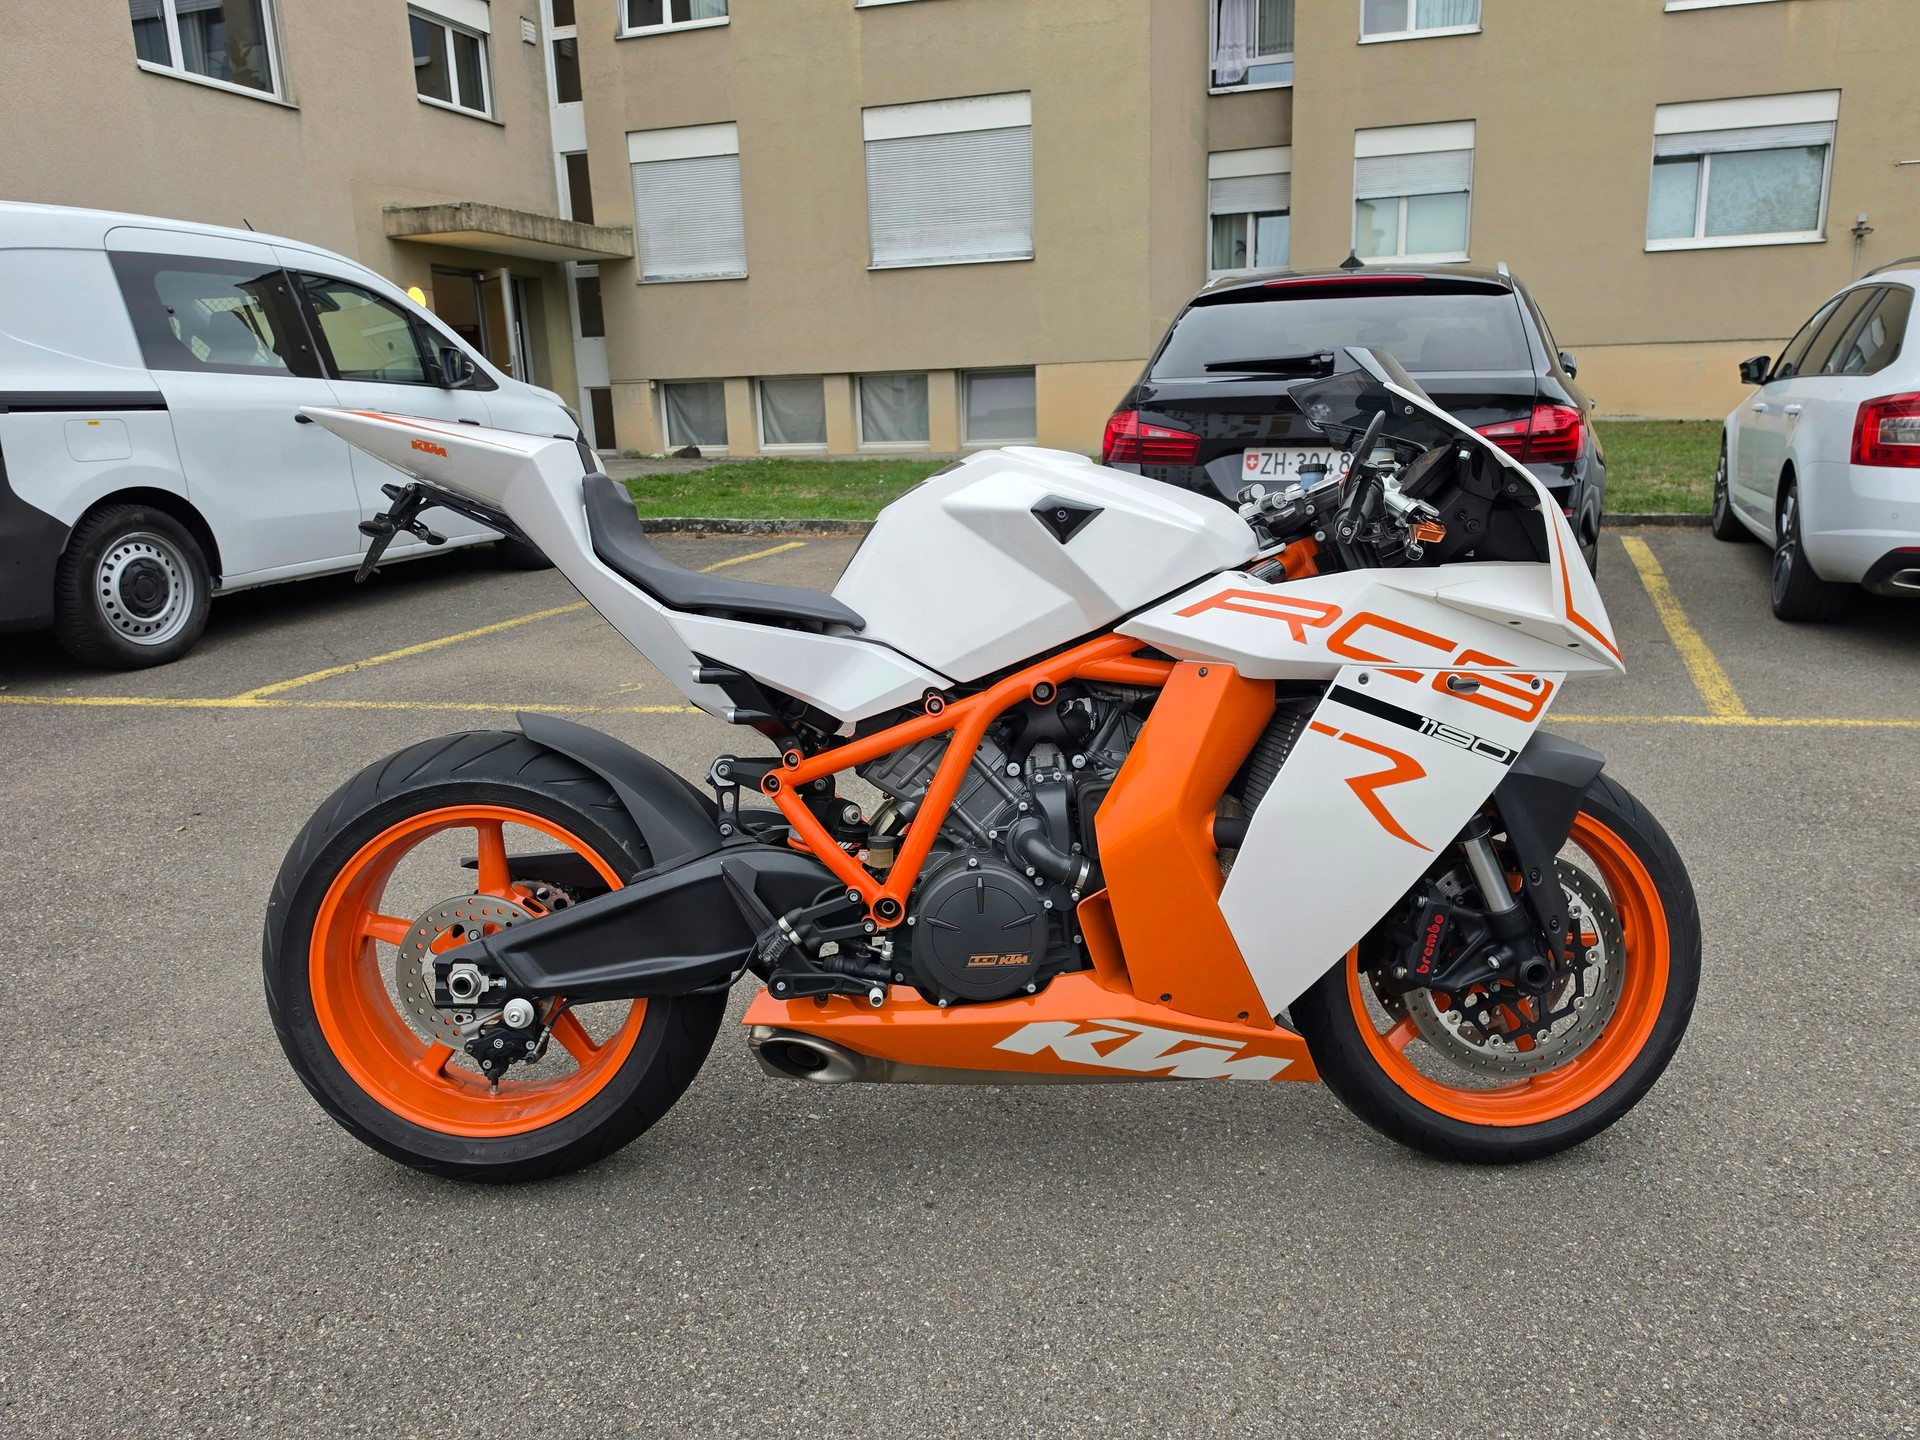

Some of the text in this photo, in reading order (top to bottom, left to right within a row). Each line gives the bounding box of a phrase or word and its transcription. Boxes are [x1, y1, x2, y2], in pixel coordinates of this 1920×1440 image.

[411, 439, 447, 457] KTM
[1172, 588, 1554, 723] RC8
[1420, 717, 1511, 762] 1190
[998, 954, 1028, 965] KTM
[1416, 914, 1444, 974] brembo
[993, 1018, 1293, 1081] KTM
